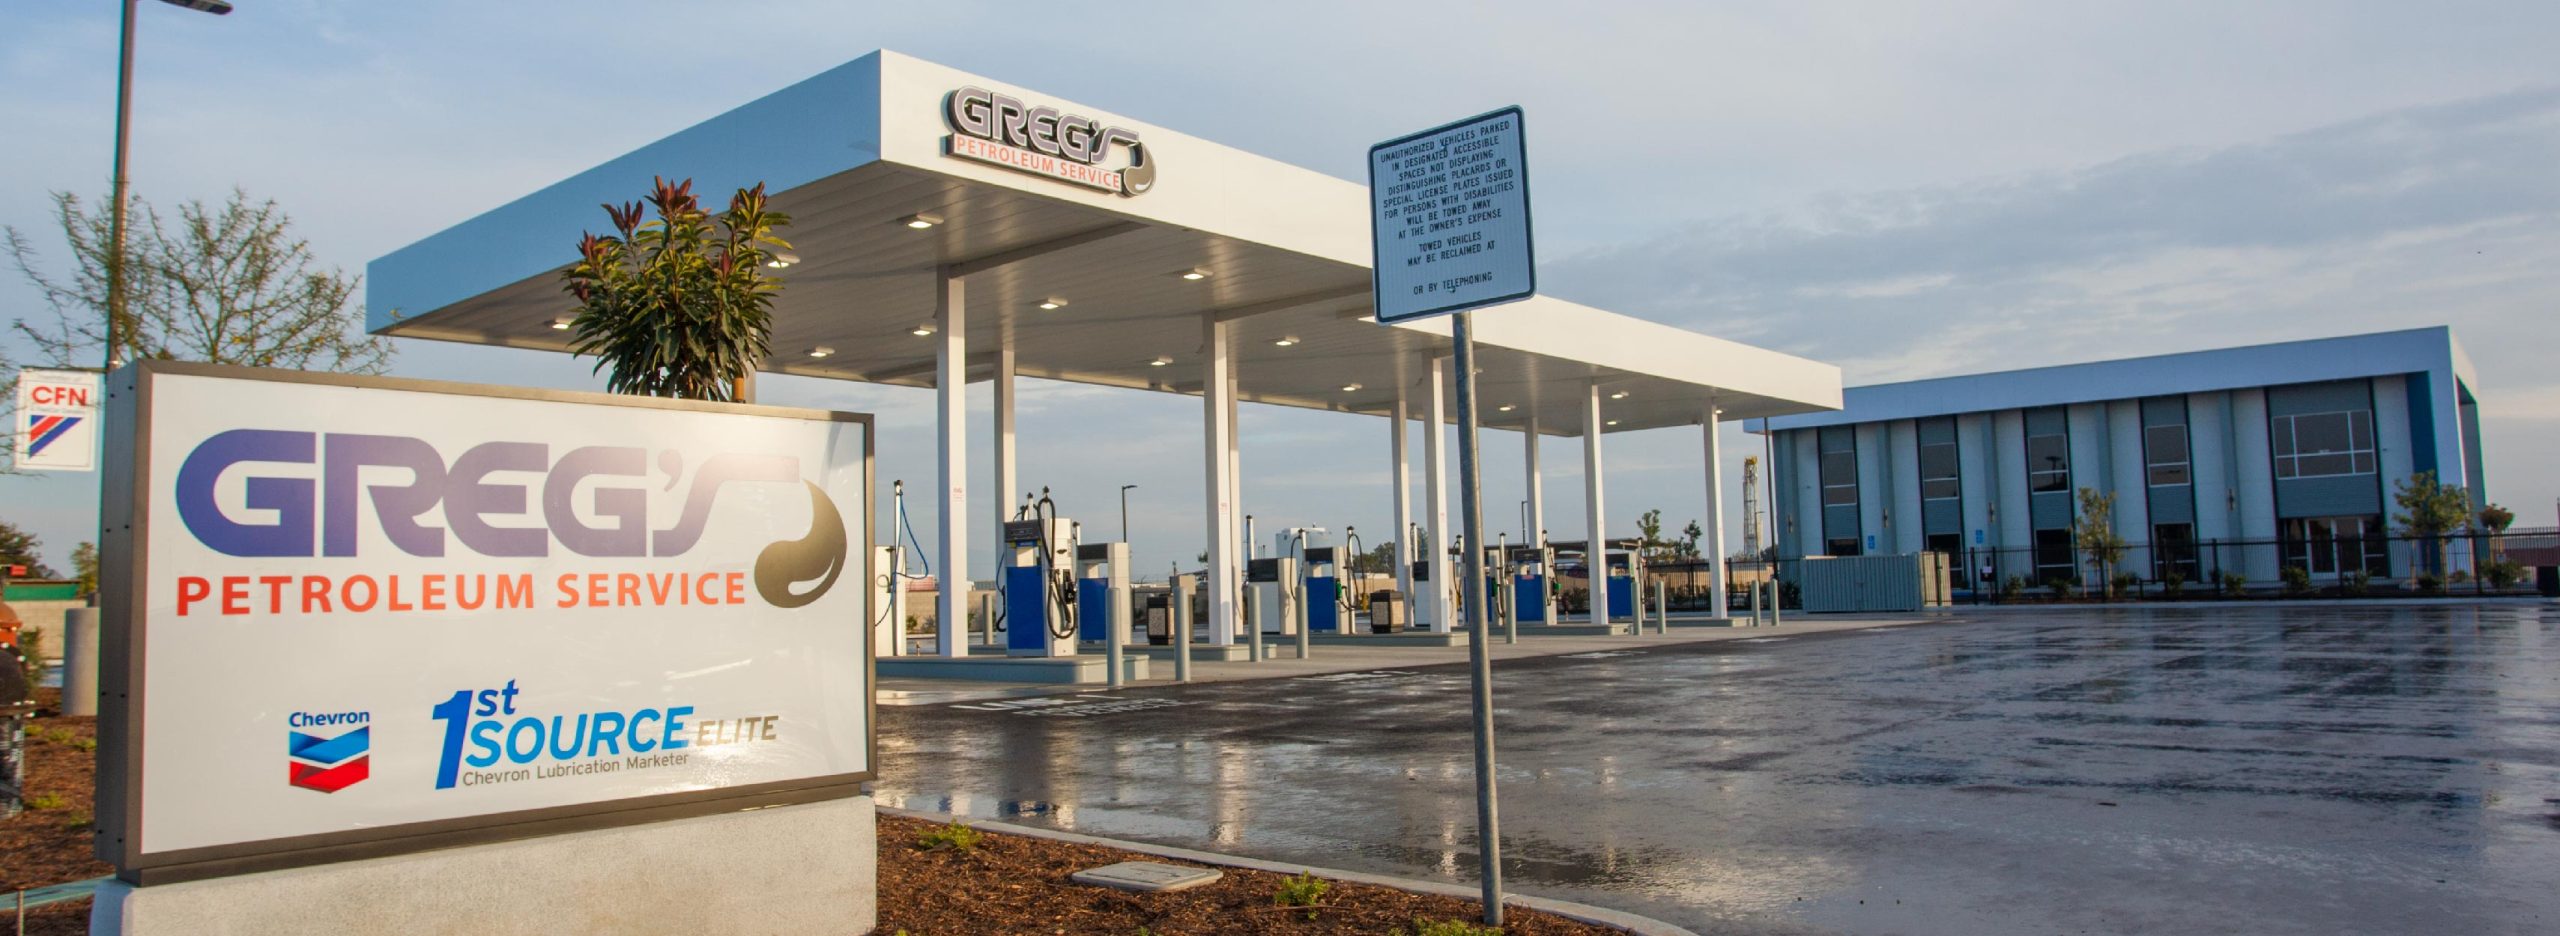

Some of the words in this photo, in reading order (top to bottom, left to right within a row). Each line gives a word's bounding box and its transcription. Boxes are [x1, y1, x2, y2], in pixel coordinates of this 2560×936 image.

[954, 85, 1140, 165] GREG'S
[1380, 142, 1435, 163] UNAUTHORIZED
[1440, 131, 1475, 147] VEHICLES
[1480, 120, 1510, 136] PARKED
[957, 136, 1054, 173] PETROLEUM
[1060, 162, 1121, 189] SERVICE
[1392, 162, 1399, 171] IN
[1405, 150, 1448, 169] DESIGNATED
[1453, 136, 1499, 154] ACCESSIBLE
[1399, 168, 1426, 181] SPACES
[1430, 162, 1444, 173] NOT
[1450, 150, 1494, 169] DISPLAYING
[1383, 195, 1414, 208] SPECIAL
[1418, 185, 1448, 200] LICENSE
[1453, 178, 1480, 191] PLATES
[1485, 169, 1514, 183] ISSUED
[1388, 175, 1446, 195] DISTINGUISHING
[1452, 162, 1491, 179] PLACARDS
[1496, 158, 1506, 168] OR
[1384, 209, 1399, 220] FOR
[1403, 201, 1437, 216] PERSONS
[1442, 196, 1459, 207] WITH
[1464, 181, 1514, 201] DISABILITIES
[1406, 215, 1423, 225] WILL
[1428, 212, 1438, 221] BE
[1443, 204, 1467, 218] TOWED
[1472, 200, 1491, 211] AWAY
[1398, 230, 1406, 240] AT
[1411, 226, 1424, 237] THE
[1429, 218, 1463, 232] OWNER'S
[1468, 209, 1502, 224] EXPENSE
[1419, 240, 1442, 252] TOWED
[1447, 231, 1482, 246] VEHICLES
[1407, 256, 1421, 267] MAY
[1426, 252, 1436, 262] BE
[1441, 244, 1481, 260] RECLAIMED
[1487, 240, 1495, 251] AT
[1413, 285, 1423, 295] OR
[1428, 282, 1438, 292] BY
[1443, 272, 1492, 289] TELEPHONING
[31, 385, 88, 407] CFN
[176, 427, 800, 558] GREG'S
[176, 572, 537, 617] PETROLEUM
[557, 571, 746, 609] SERVICE
[289, 710, 370, 728] Chevron
[465, 705, 694, 769] SOURCE
[697, 715, 779, 747] ELITE
[463, 767, 530, 787] Chevron
[537, 758, 621, 780] Lubrication
[626, 752, 689, 771] Marketer
